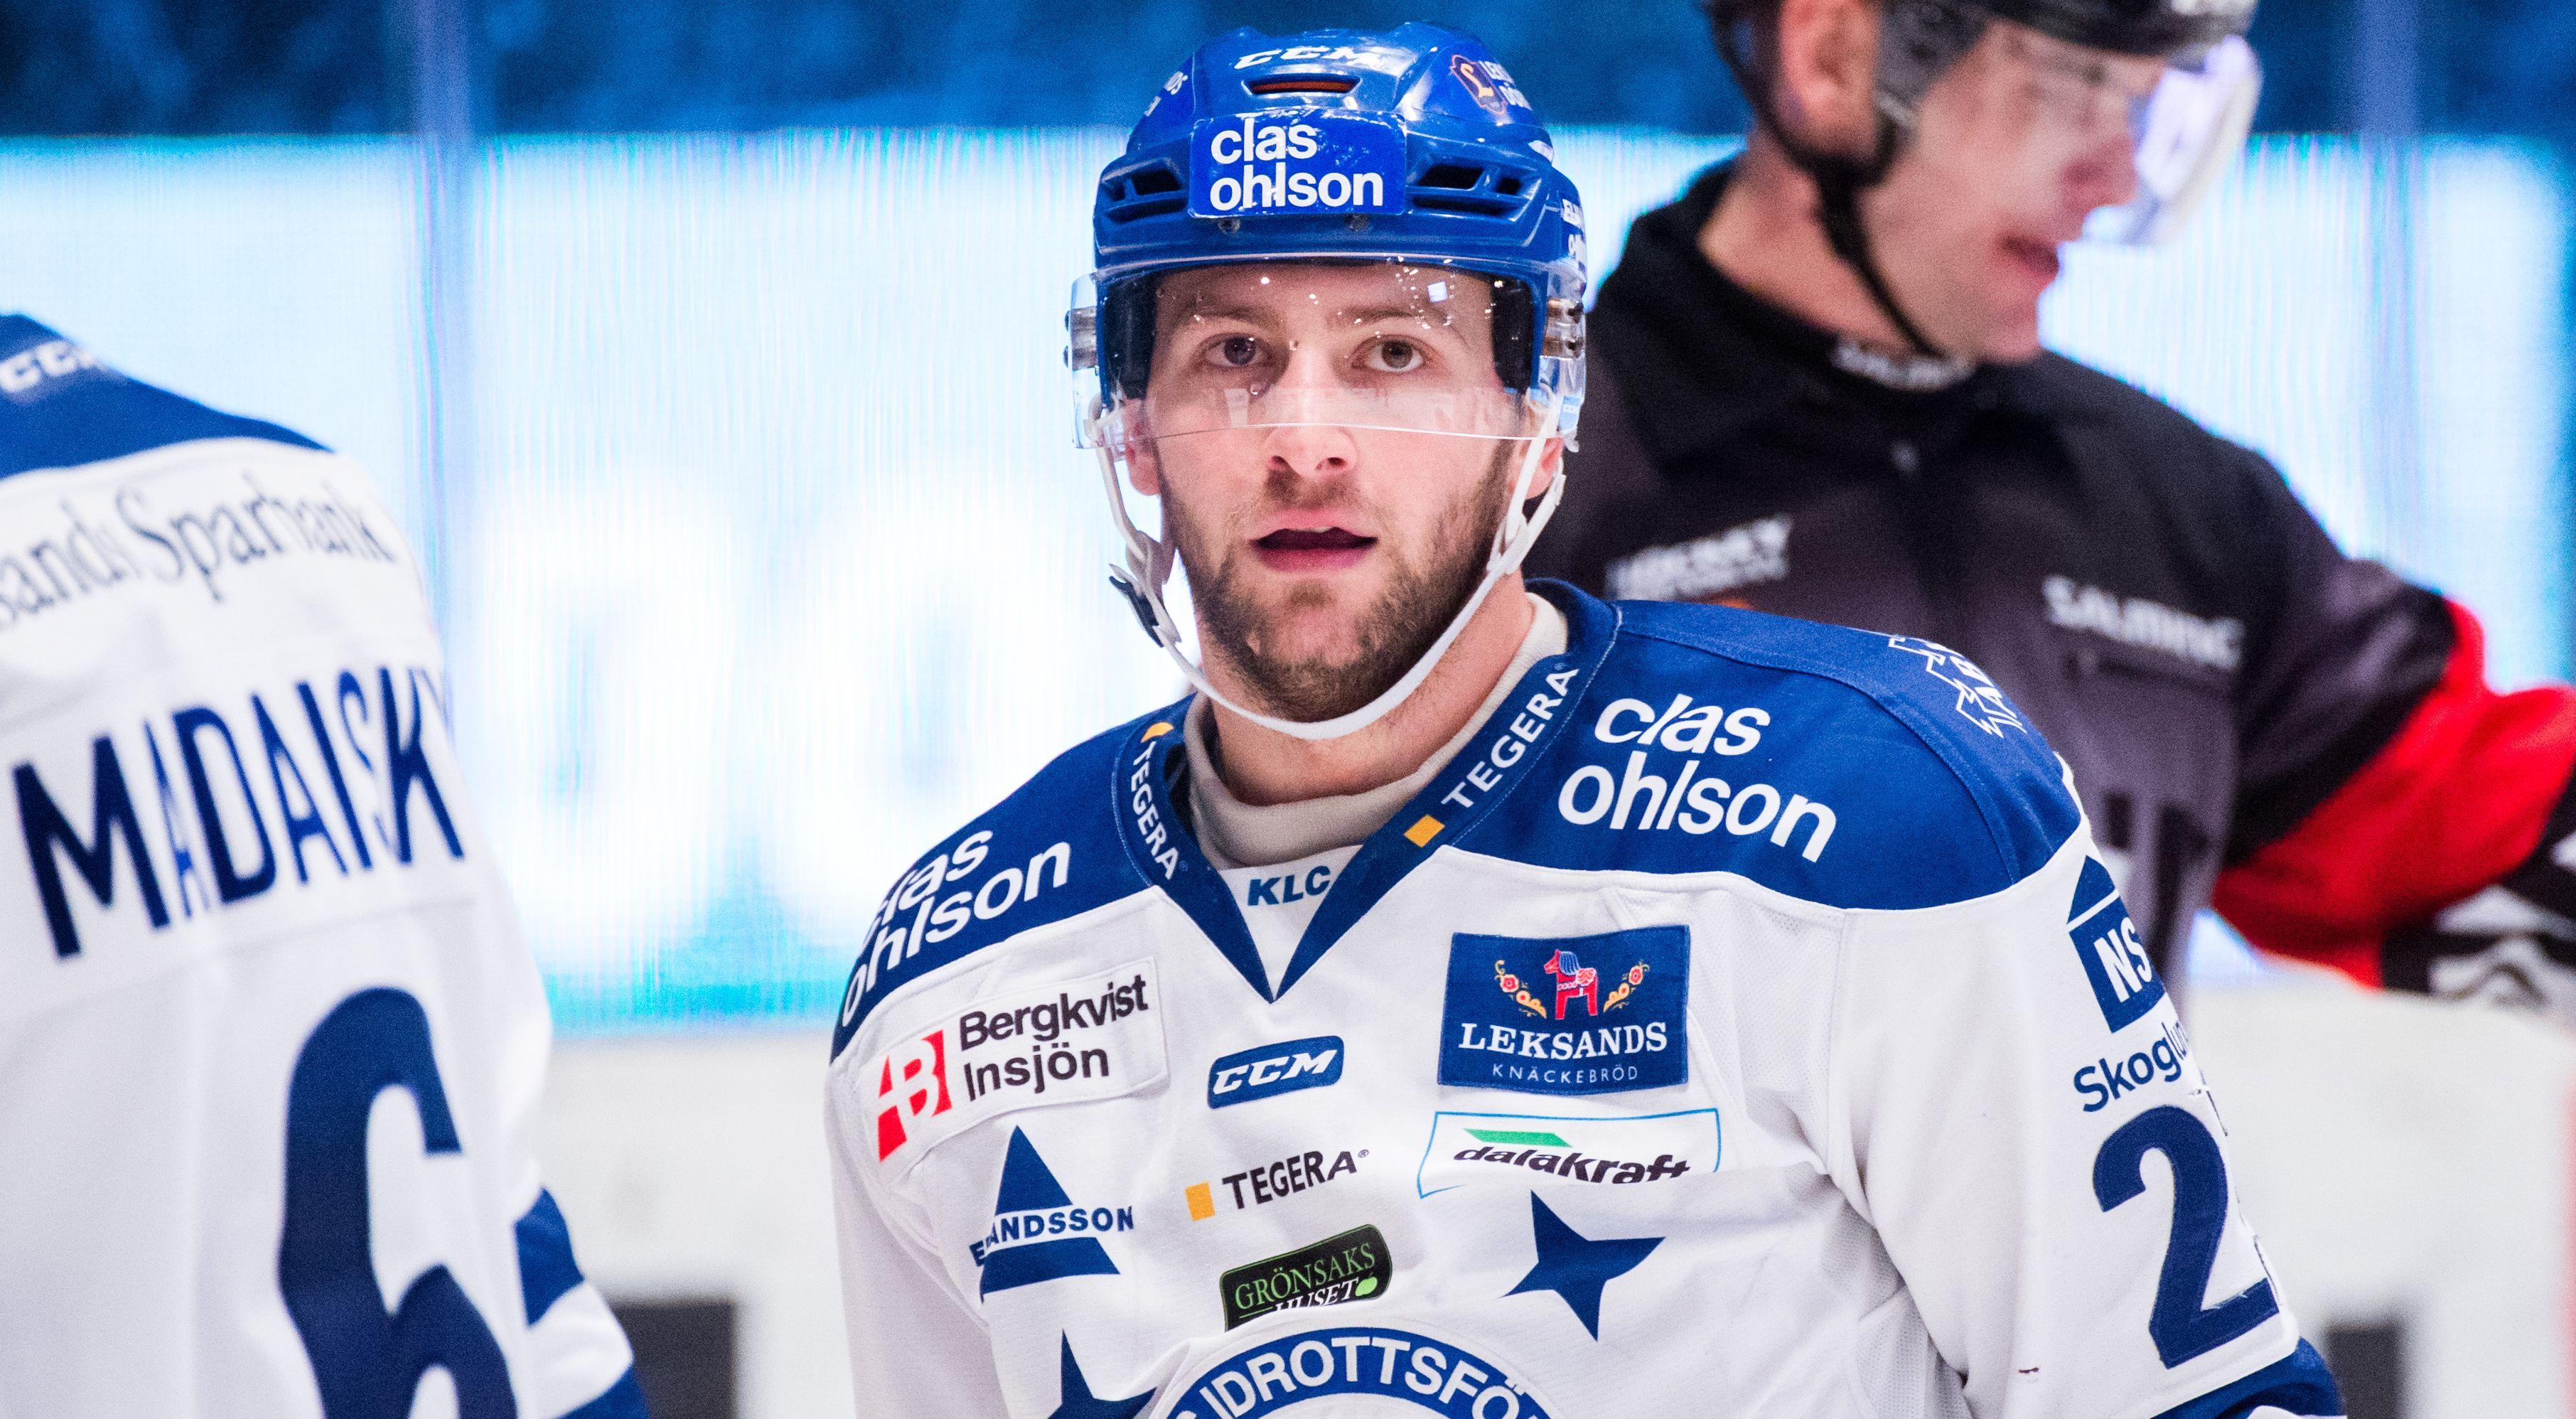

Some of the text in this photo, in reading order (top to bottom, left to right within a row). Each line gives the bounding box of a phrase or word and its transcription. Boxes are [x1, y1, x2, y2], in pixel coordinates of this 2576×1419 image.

[1234, 46, 1382, 70] CCM
[1211, 118, 1317, 165] clas
[1210, 163, 1384, 211] ohlson
[1593, 693, 1771, 756] clas
[1558, 750, 1837, 863] ohlson
[877, 830, 994, 926] las
[1247, 864, 1333, 907] KLC
[960, 974, 1149, 1052] Bergkvist
[1458, 1021, 1668, 1061] LEKSANDS
[963, 1042, 1110, 1102] Insjön
[1213, 1049, 1338, 1096] CCM
[1492, 1063, 1638, 1084] KNÄCKEBRÖD
[1453, 1146, 1691, 1184] dalakraft
[276, 986, 519, 1419] 6
[1235, 1243, 1376, 1310] GRÖNSAKS
[1198, 1336, 1541, 1419] IDROTTSFÖ
